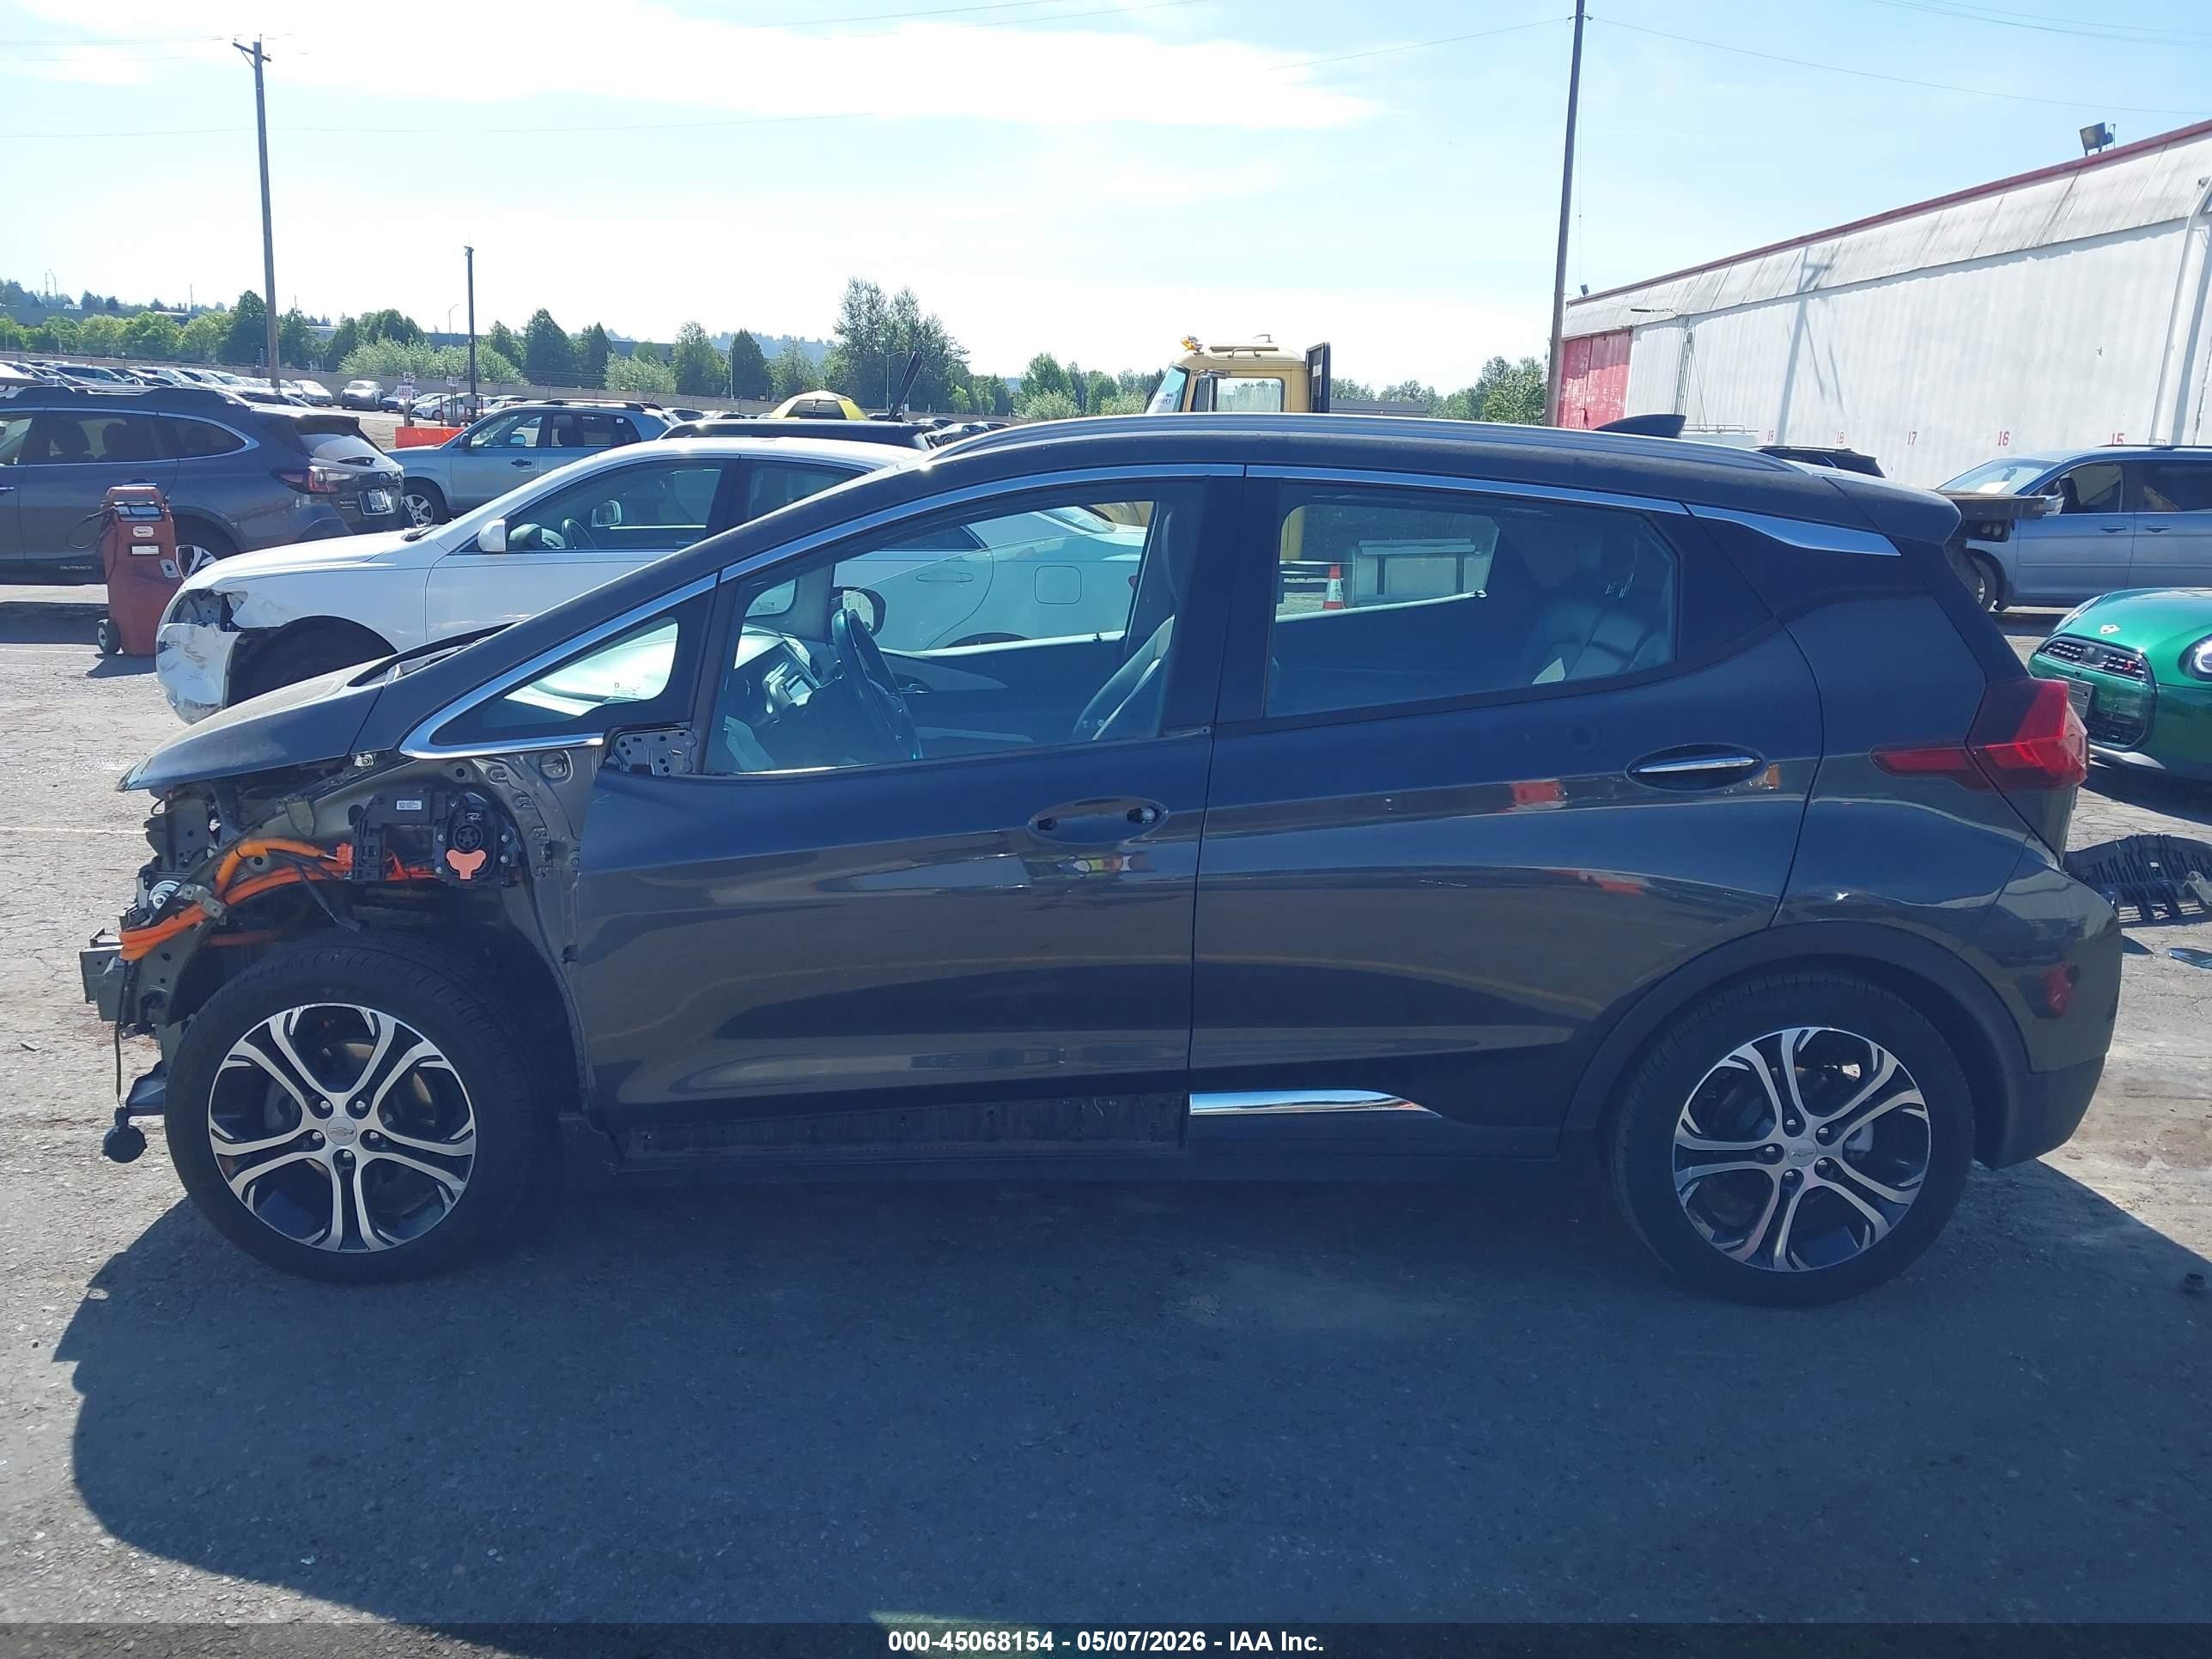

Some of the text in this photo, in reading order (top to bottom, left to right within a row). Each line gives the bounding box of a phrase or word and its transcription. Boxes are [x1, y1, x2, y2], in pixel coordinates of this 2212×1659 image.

[1767, 429, 1774, 441] 19
[1836, 432, 1844, 444] 18
[1907, 431, 1917, 445] 17
[1997, 430, 2010, 446] 16
[2111, 433, 2125, 445] 15
